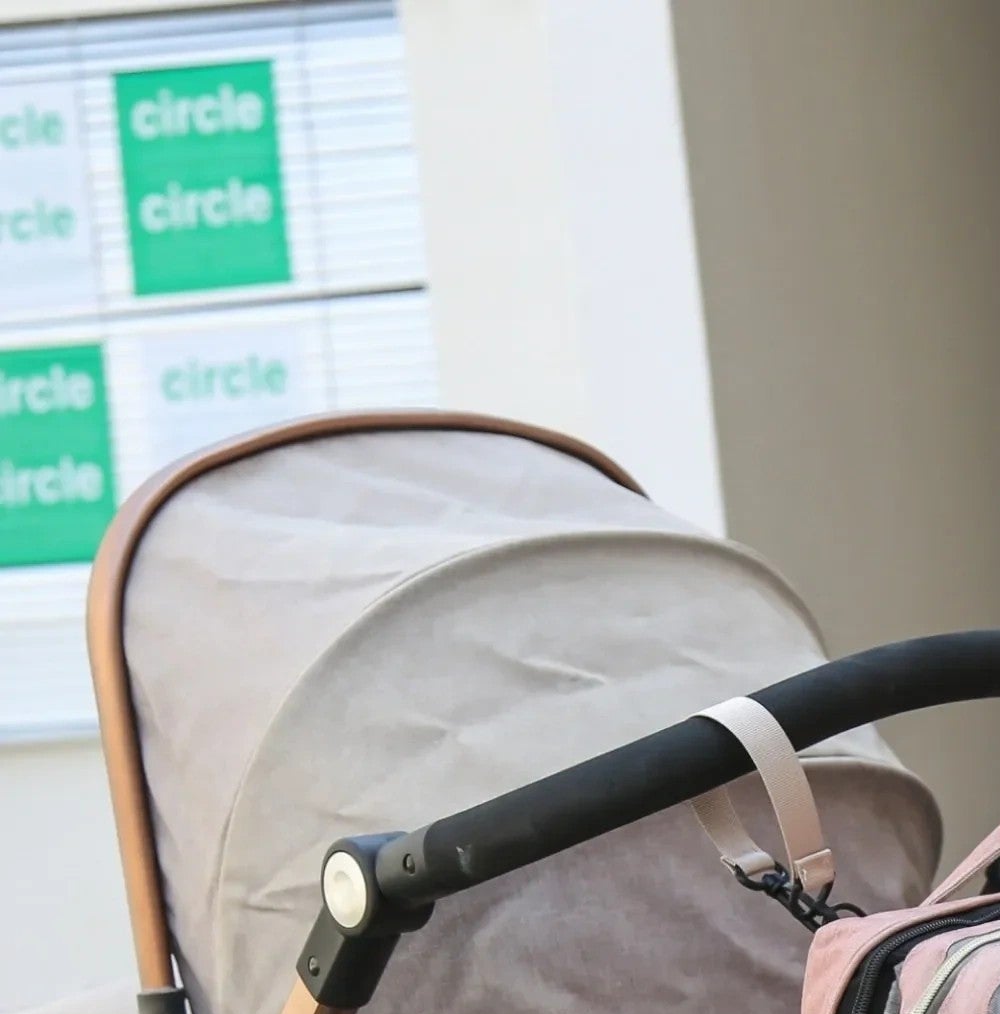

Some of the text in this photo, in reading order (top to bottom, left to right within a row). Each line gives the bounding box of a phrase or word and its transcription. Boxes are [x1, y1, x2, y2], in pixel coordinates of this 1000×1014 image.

[132, 84, 263, 138] circle
[140, 178, 273, 232] circle
[161, 353, 288, 403] circle
